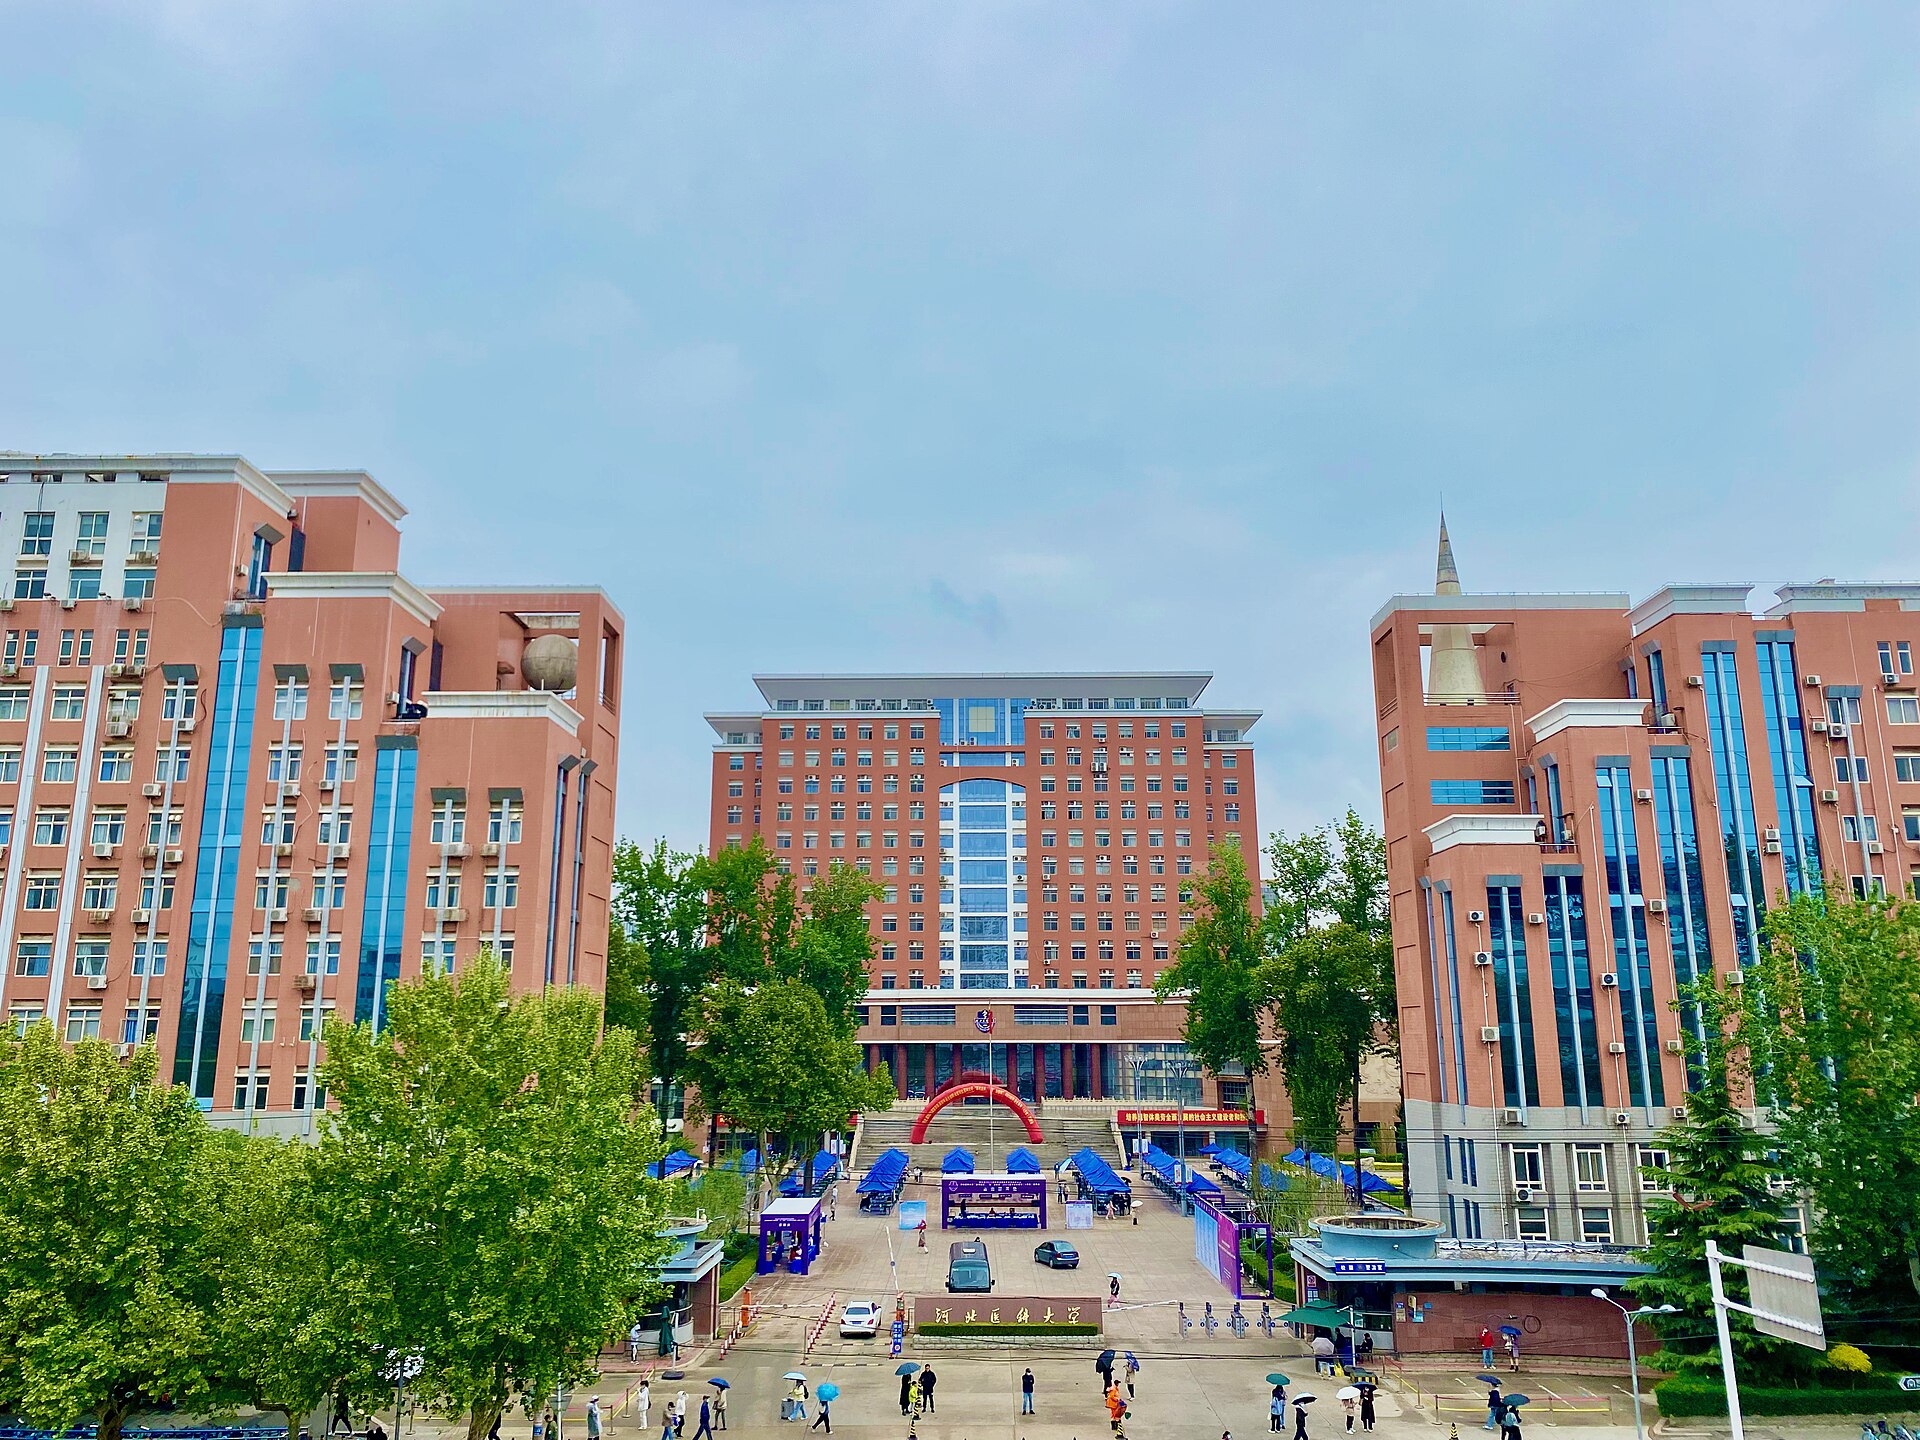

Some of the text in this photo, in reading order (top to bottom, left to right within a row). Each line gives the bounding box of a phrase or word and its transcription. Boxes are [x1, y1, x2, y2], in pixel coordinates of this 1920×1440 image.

[935, 1307, 1081, 1324] 河北医科大学
